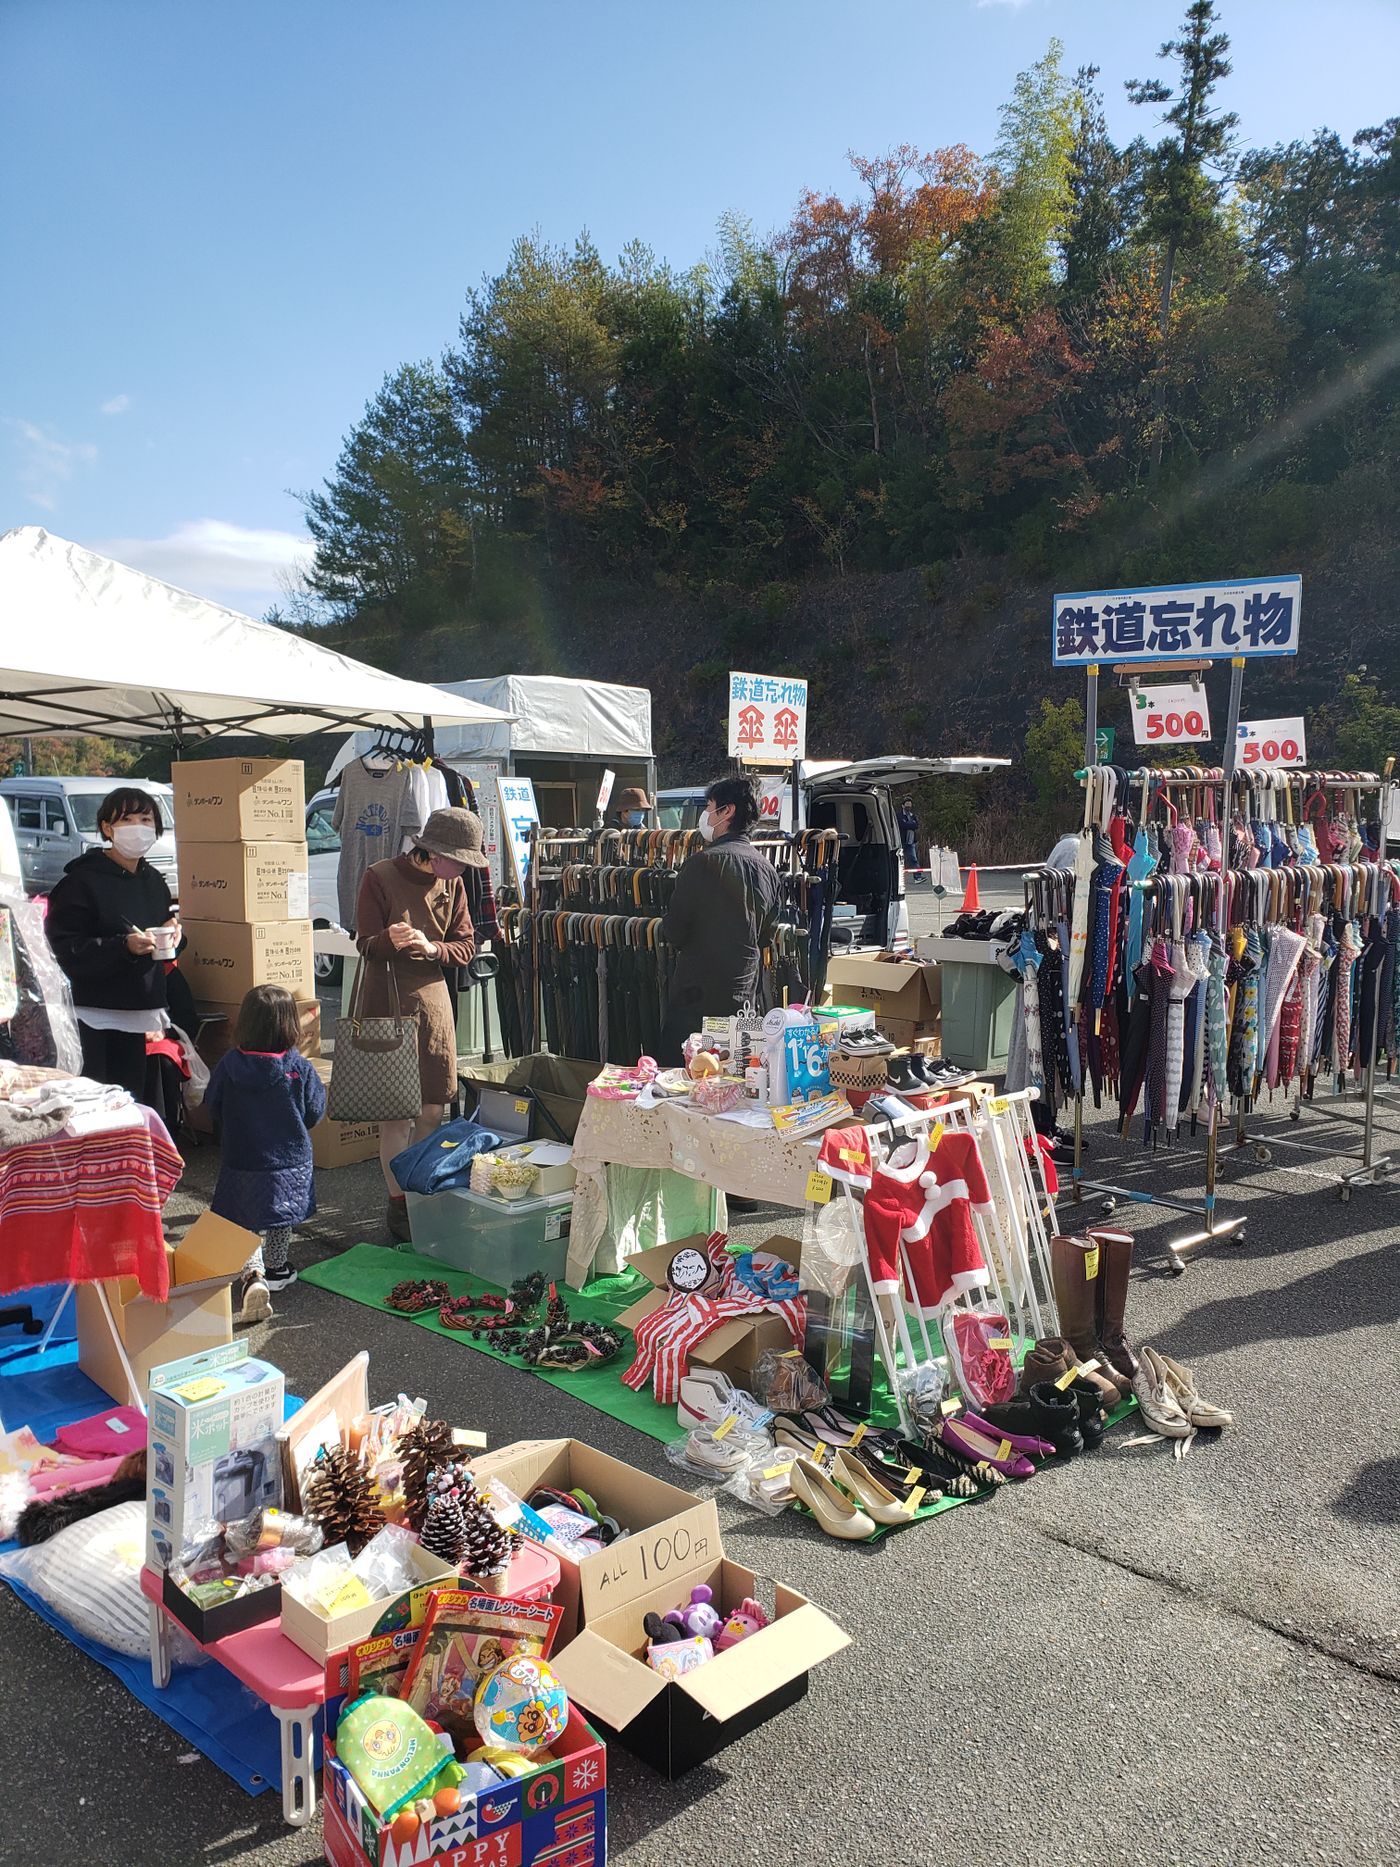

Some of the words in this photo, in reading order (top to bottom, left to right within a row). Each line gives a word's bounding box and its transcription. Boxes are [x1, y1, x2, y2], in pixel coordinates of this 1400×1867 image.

[1057, 592, 1294, 656] 鉄道忘れ物
[732, 676, 806, 707] 鉄道忘れ物
[503, 786, 531, 801] 鉄道
[267, 809, 284, 818] No.1
[271, 890, 287, 899] No.1
[280, 969, 295, 979] No.1
[354, 1126, 371, 1138] No.1
[600, 1563, 627, 1590] ALL
[469, 1596, 554, 1620] 名場面レジャーシート
[357, 1637, 391, 1656] オリジナル
[400, 1738, 416, 1768] MELON
